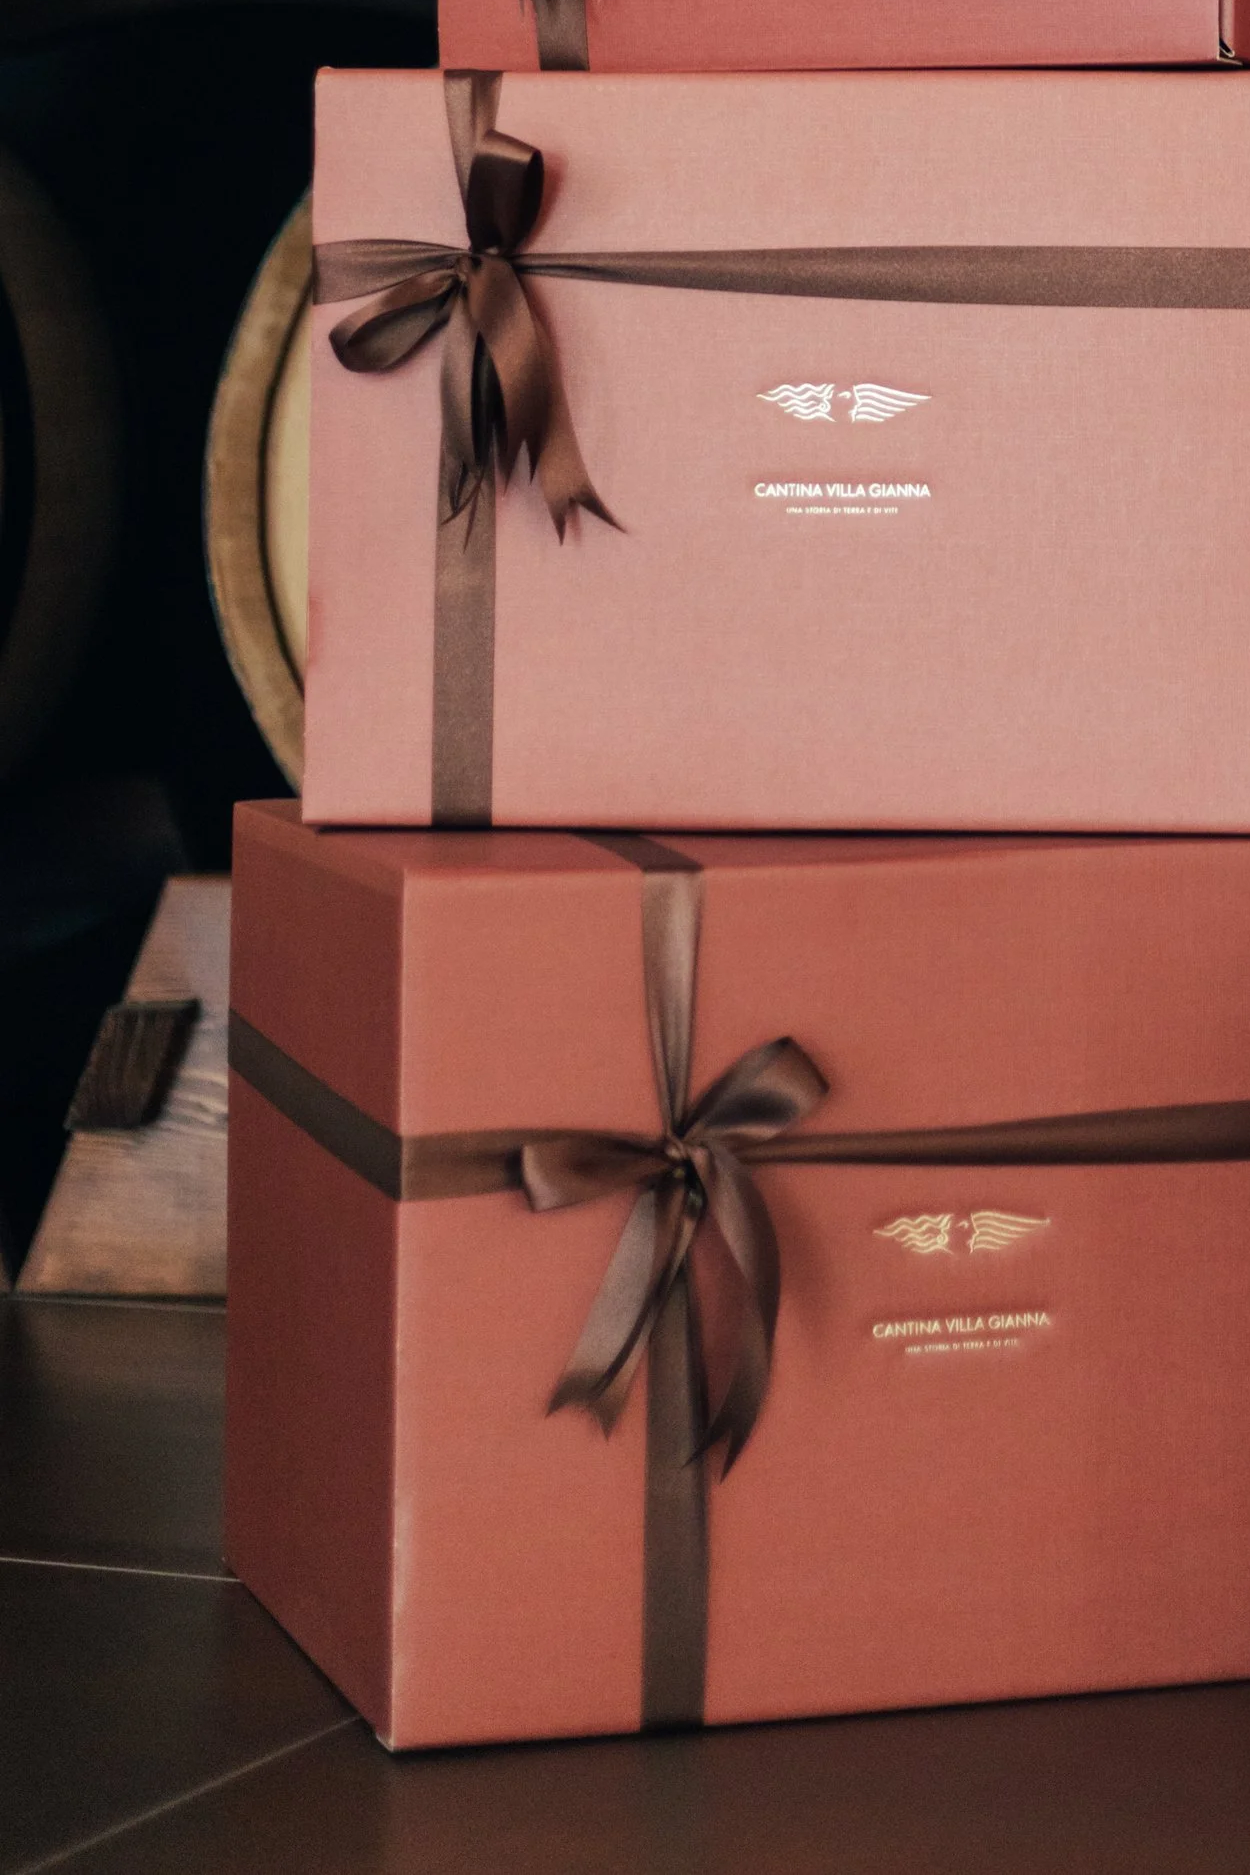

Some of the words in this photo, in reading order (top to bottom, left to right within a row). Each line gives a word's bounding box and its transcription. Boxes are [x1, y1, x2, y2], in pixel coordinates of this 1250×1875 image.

[754, 483, 823, 497] CANTINA
[826, 483, 866, 497] VILLA
[869, 483, 931, 497] GIANNA
[872, 1320, 942, 1338] CANTINA
[945, 1317, 984, 1334] VILLA
[988, 1312, 1050, 1329] GIANNA
